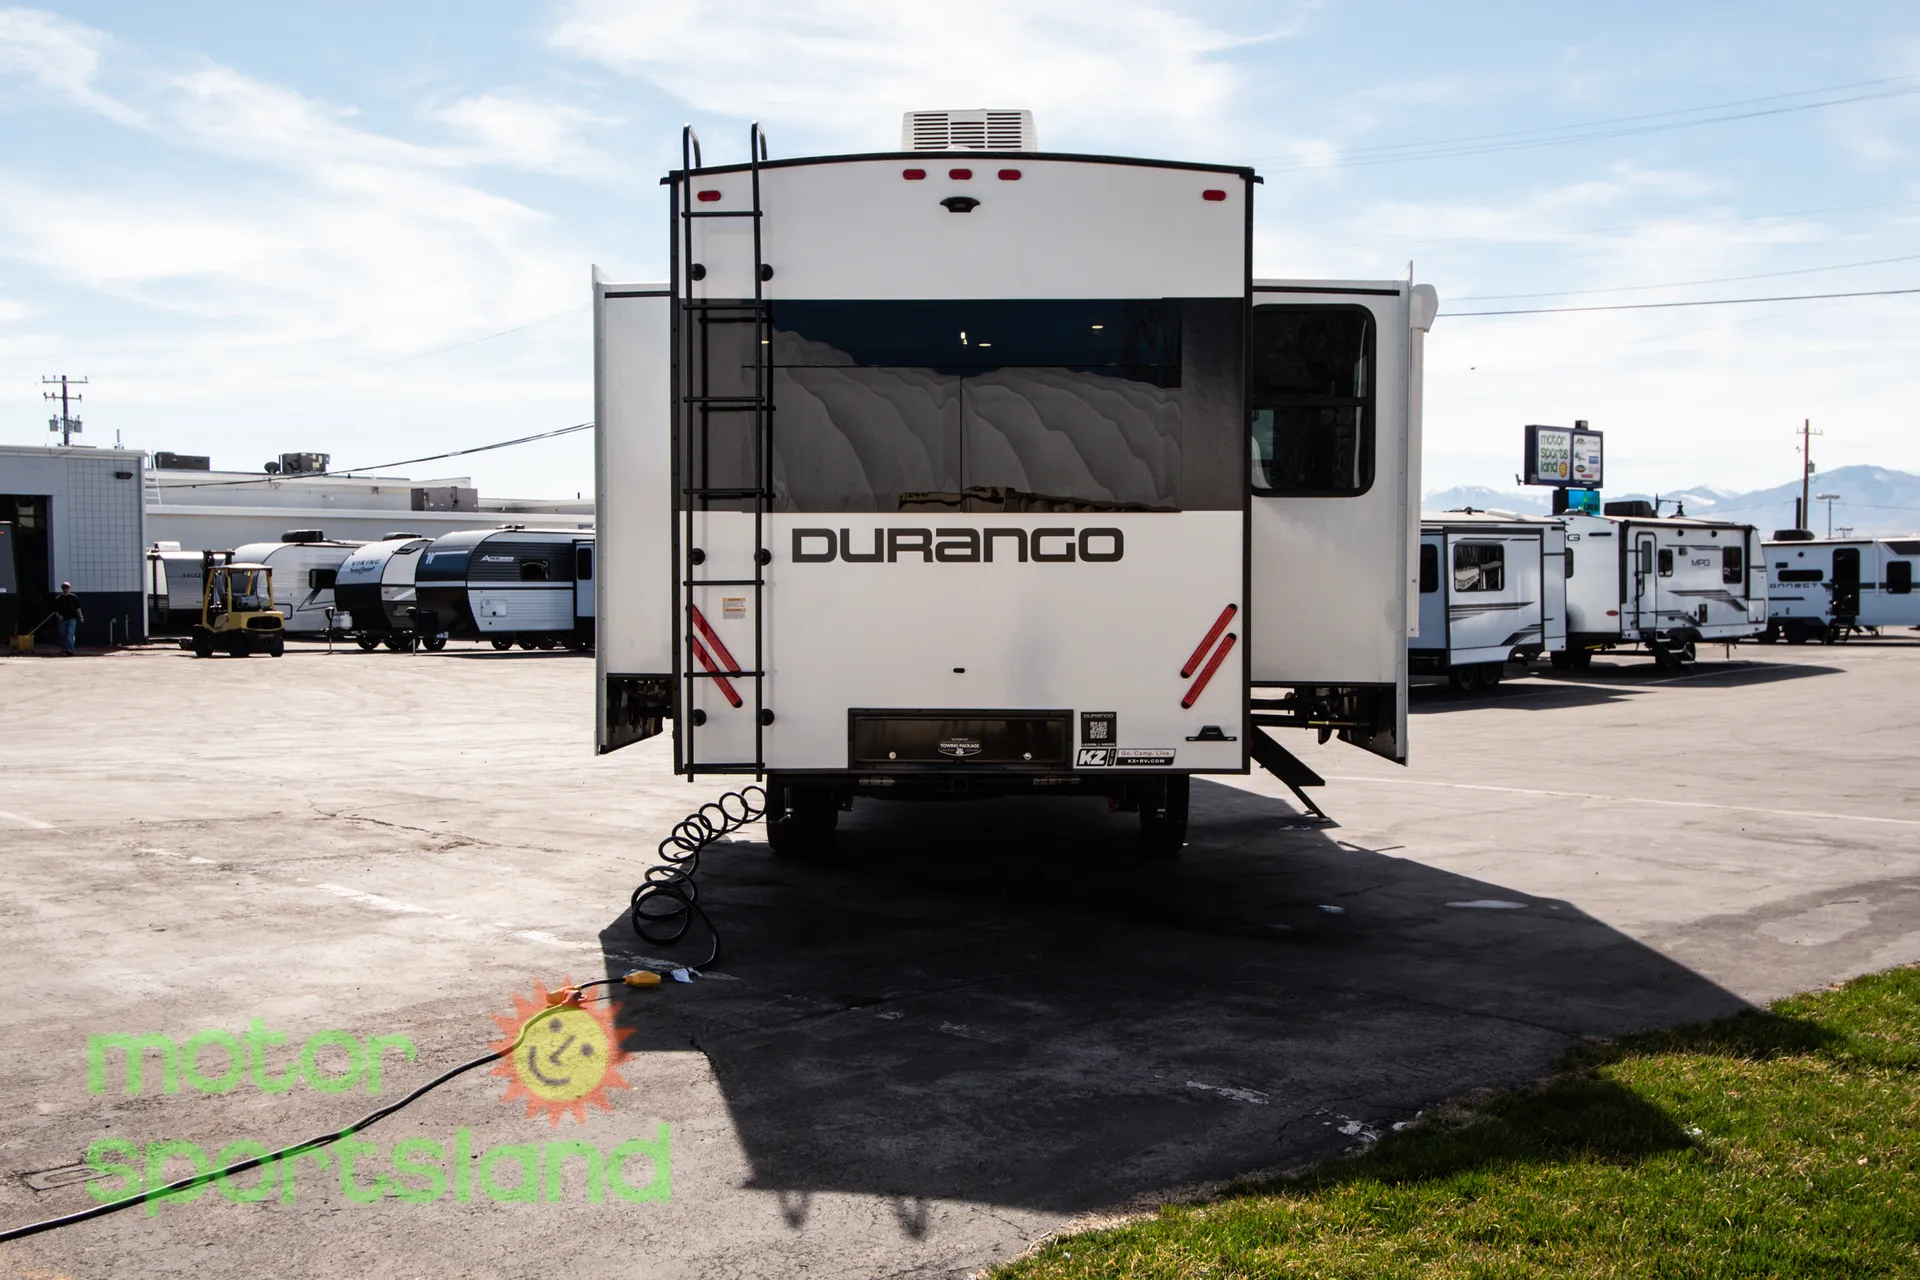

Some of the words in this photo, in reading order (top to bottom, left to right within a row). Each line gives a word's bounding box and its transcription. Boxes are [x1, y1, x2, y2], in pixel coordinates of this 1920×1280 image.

[1541, 433, 1566, 446] motor
[1540, 447, 1568, 460] sports
[1541, 460, 1558, 473] land
[351, 559, 381, 567] VIKING
[1691, 558, 1711, 567] MPG
[1078, 750, 1107, 765] KZ
